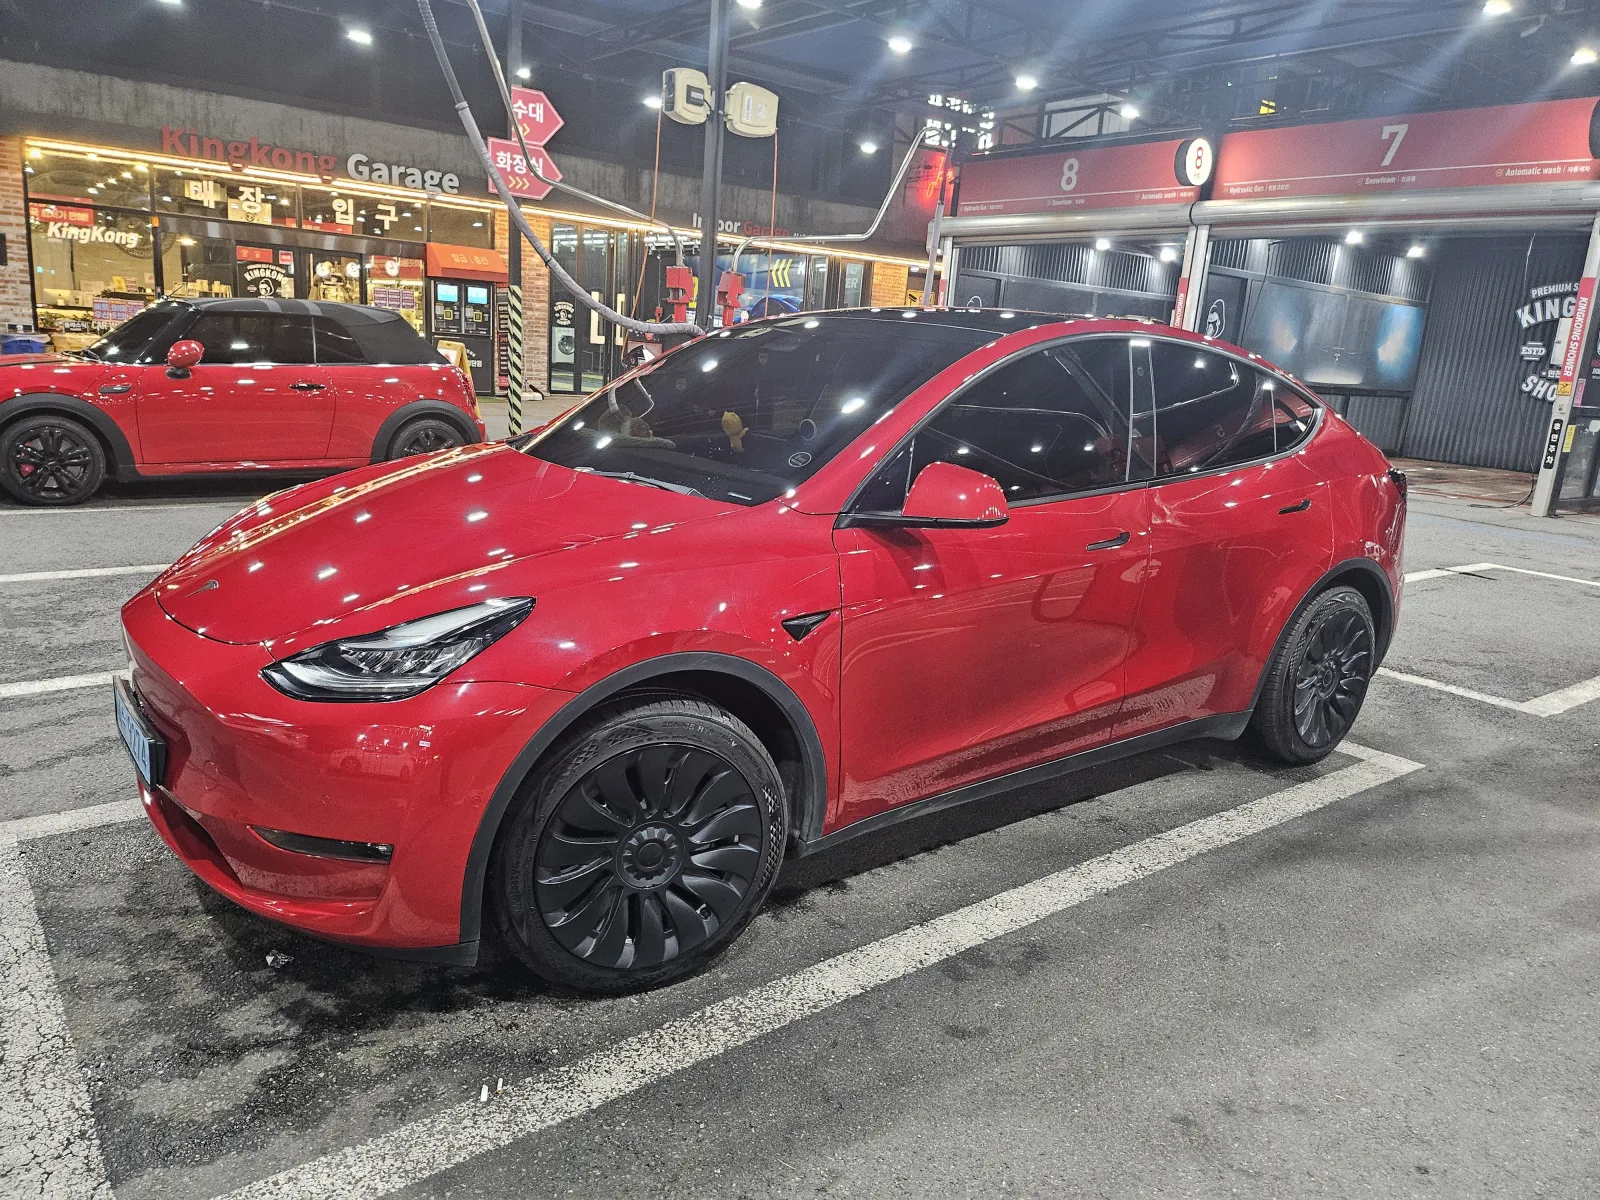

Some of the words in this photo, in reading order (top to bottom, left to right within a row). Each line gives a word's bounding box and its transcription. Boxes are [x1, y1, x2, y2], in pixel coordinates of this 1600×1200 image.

[1195, 146, 1204, 170] 8
[1380, 123, 1409, 167] 7
[161, 124, 338, 185] Kingkong
[346, 153, 460, 199] Garage
[1060, 157, 1079, 191] 8
[1505, 166, 1541, 177] Automatic
[1542, 165, 1562, 175] wash
[47, 222, 139, 249] KingKong
[1531, 283, 1572, 298] PREMIUM
[1517, 297, 1576, 328] KING
[1572, 296, 1589, 341] KINGKONG
[1520, 346, 1546, 356] ESTD
[1563, 340, 1579, 377] SHOWER
[1521, 375, 1558, 402] SHO
